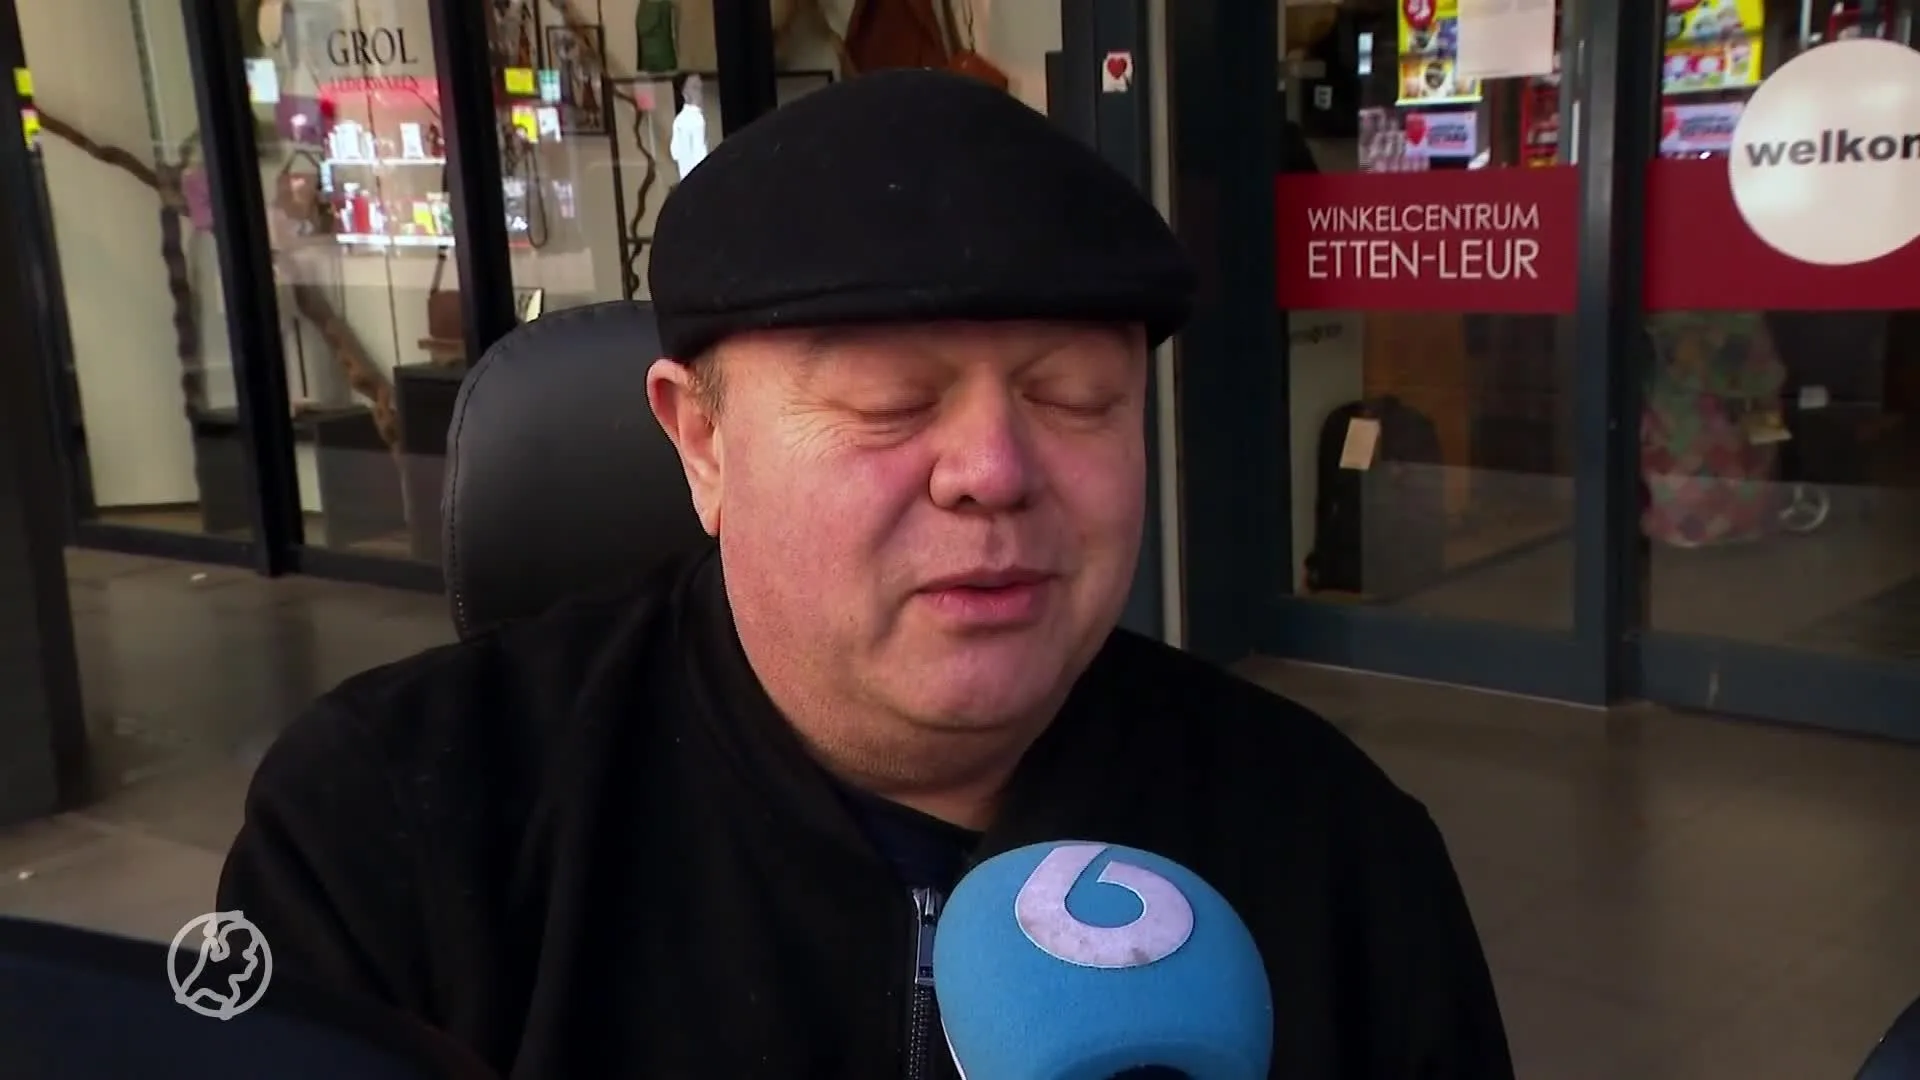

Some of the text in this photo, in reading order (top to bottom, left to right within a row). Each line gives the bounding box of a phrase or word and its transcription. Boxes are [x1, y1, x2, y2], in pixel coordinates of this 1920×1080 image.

[327, 28, 417, 66] GROL
[1308, 203, 1539, 231] WINKELCENTRUM
[1308, 240, 1539, 279] ETTEN-LEUR
[1015, 842, 1194, 968] 6
